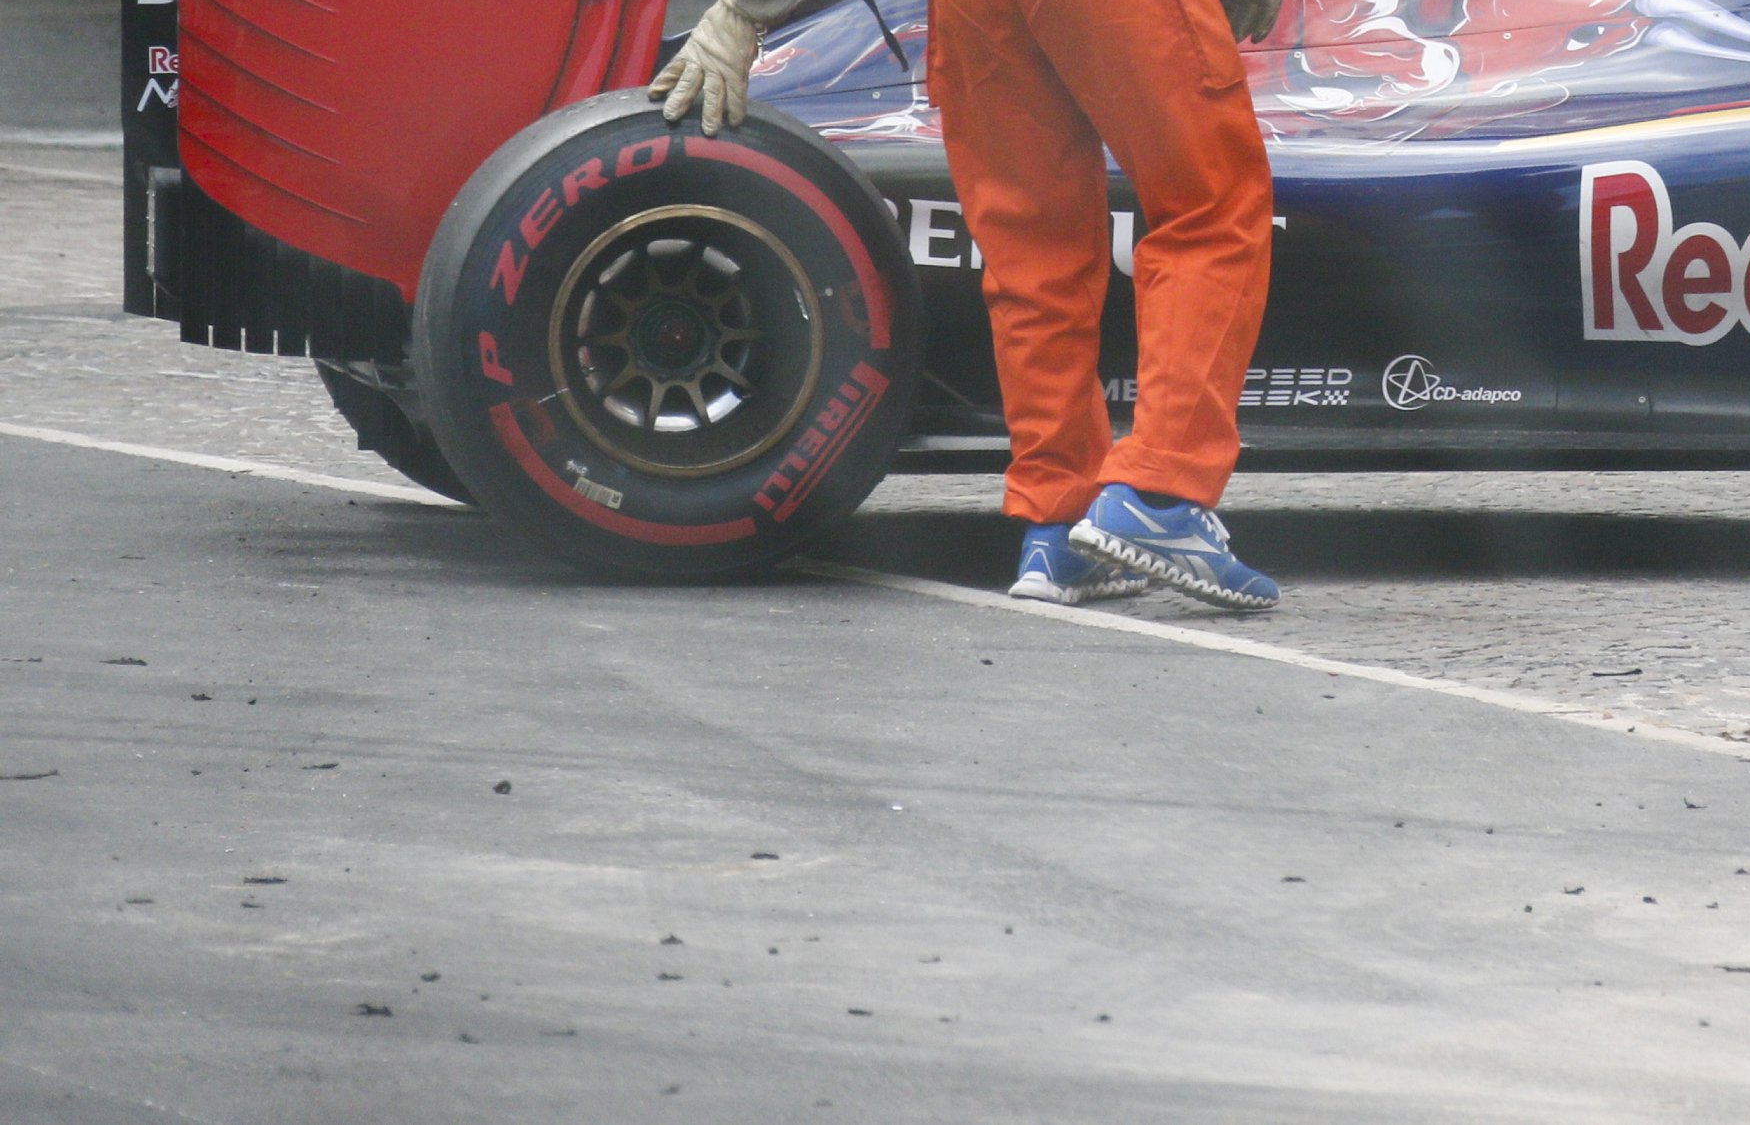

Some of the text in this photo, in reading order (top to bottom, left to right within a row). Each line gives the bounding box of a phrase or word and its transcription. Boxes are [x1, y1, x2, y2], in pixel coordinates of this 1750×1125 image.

[477, 134, 673, 386] P ZERO
[1243, 368, 1353, 386] PEED
[1238, 390, 1321, 406] EEK
[1434, 386, 1522, 403] CD-adapco
[753, 360, 891, 523] PIRELLI
